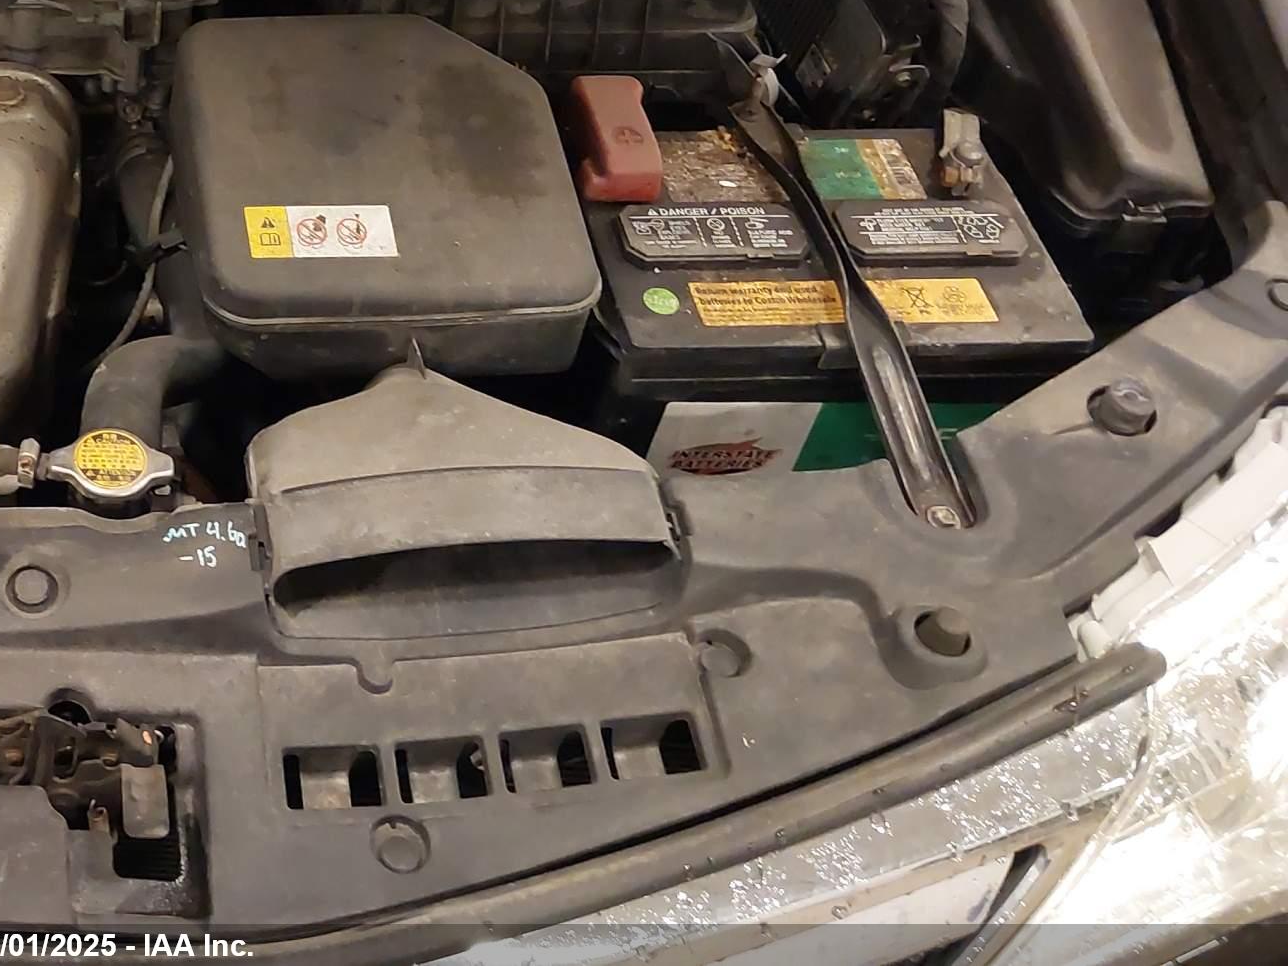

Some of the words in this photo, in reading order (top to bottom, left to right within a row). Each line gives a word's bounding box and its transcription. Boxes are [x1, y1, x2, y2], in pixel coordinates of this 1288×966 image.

[658, 207, 709, 217] DANGER
[720, 207, 765, 216] POISON
[730, 286, 772, 296] warranty
[743, 296, 753, 306] to
[787, 295, 837, 305] Wholesale
[669, 449, 776, 459] INTERSTATE
[669, 459, 764, 469] BATTERIES
[179, 545, 217, 567] -15
